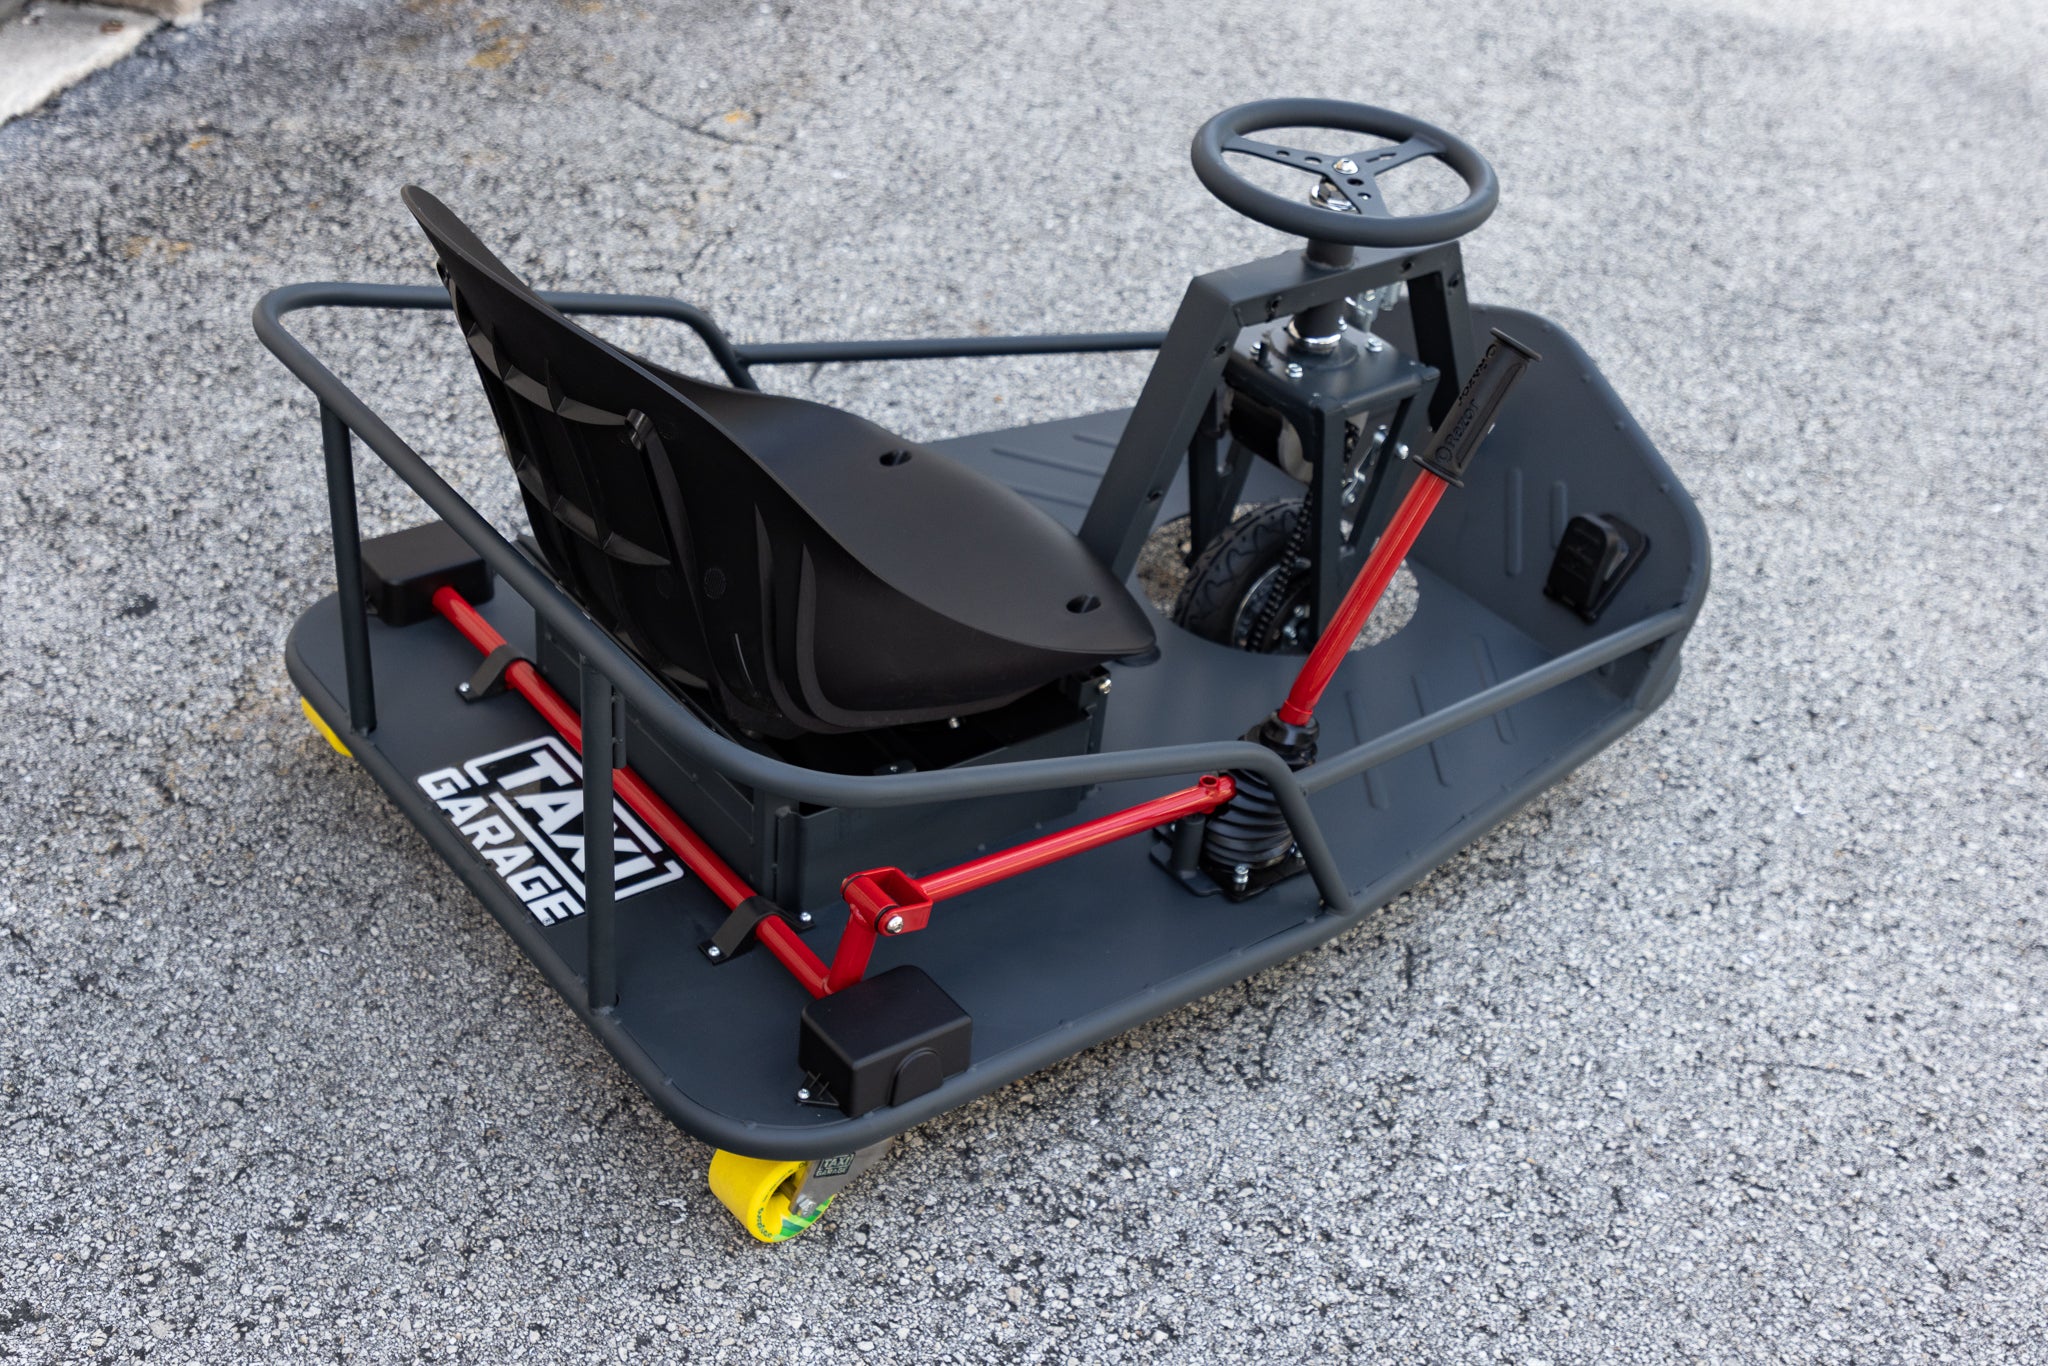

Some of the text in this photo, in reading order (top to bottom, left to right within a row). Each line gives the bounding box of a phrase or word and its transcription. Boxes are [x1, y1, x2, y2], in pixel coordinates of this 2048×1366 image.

[1444, 398, 1480, 447] Razor
[418, 767, 586, 926] GARAGE
[824, 1156, 851, 1167] TAXI
